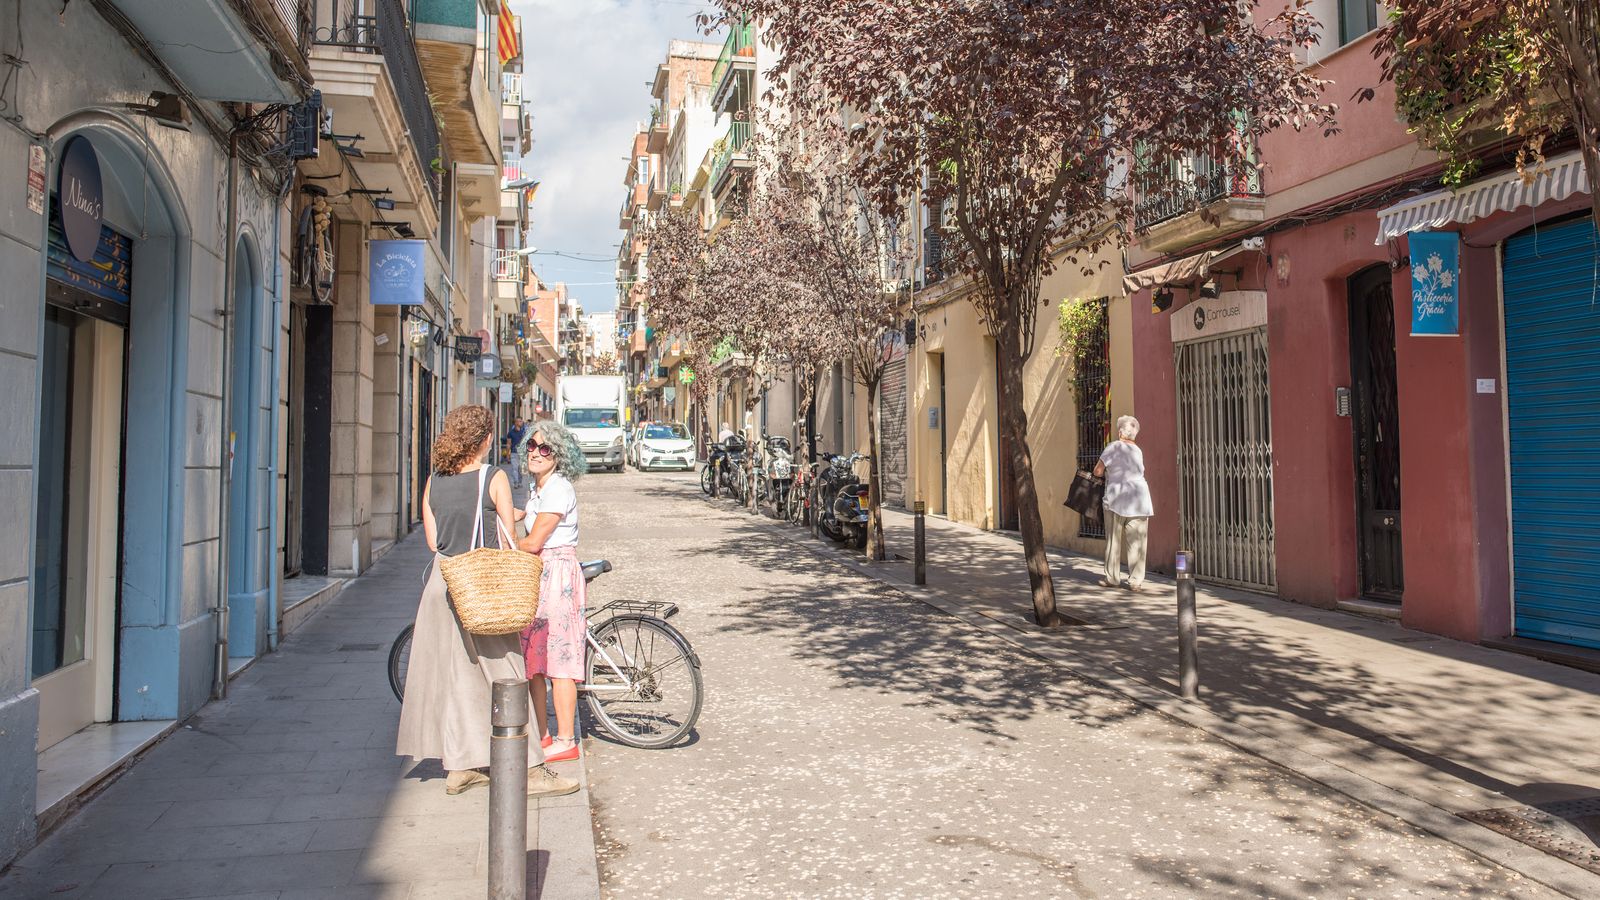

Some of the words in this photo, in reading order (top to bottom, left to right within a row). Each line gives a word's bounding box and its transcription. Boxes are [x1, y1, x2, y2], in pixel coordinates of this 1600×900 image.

[65, 177, 101, 220] Nina's
[376, 258, 387, 268] La
[1206, 303, 1241, 322] Carrousel
